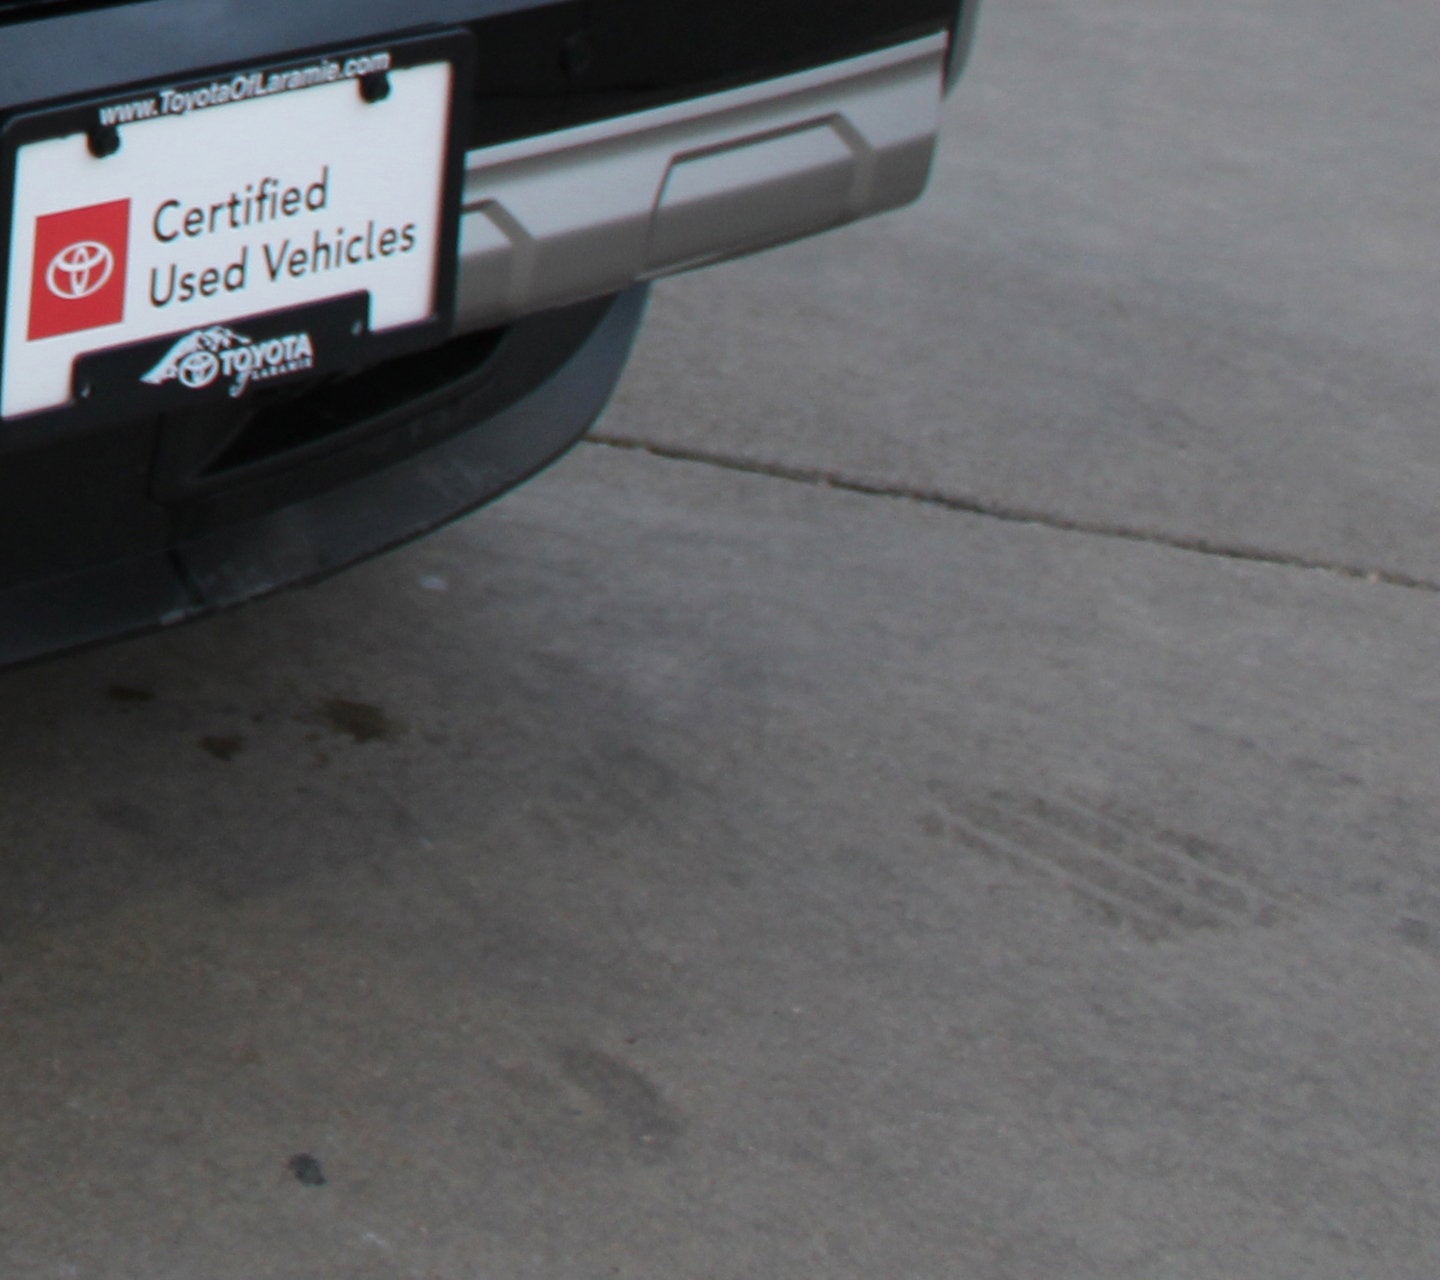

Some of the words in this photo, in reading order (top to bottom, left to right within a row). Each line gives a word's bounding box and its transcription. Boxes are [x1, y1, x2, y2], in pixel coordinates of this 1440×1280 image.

[99, 51, 390, 127] www.ToyotaOfLaramie.com
[152, 165, 329, 244] Certified
[149, 245, 248, 309] Used
[262, 219, 416, 283] Vehicles
[219, 332, 314, 377] TOYOTA
